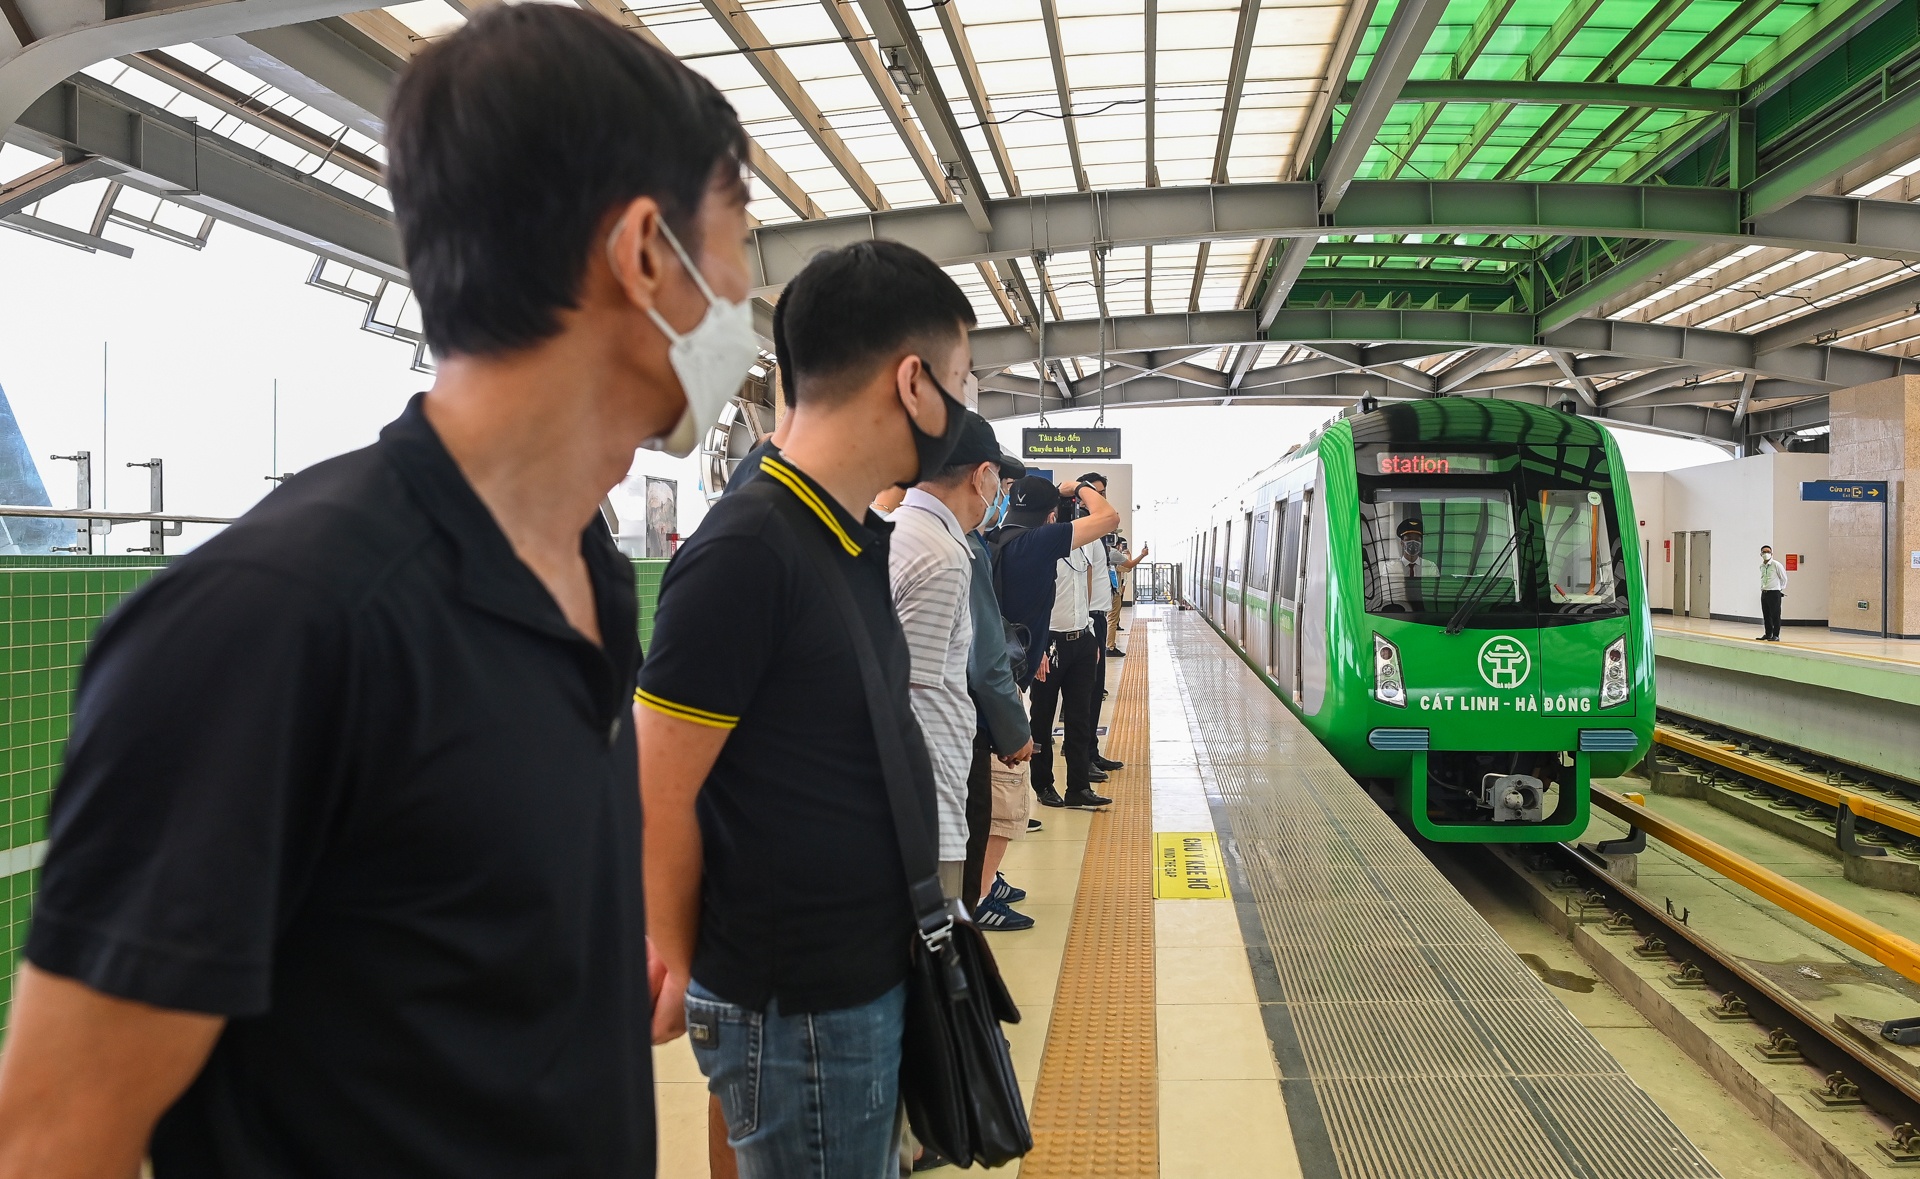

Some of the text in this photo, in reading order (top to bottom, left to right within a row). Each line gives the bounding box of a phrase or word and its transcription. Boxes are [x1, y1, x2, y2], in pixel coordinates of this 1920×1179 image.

[1054, 432, 1066, 442] sắp
[1067, 432, 1080, 442] đến
[1381, 455, 1449, 473] station
[1420, 692, 1454, 711] CÁT
[1460, 696, 1499, 711] LINH
[1515, 694, 1537, 712] HÀ
[1544, 694, 1591, 712] ĐÔNG
[1182, 838, 1207, 852] CHÚ
[1164, 859, 1177, 867] THE
[1185, 860, 1207, 875] KHE
[1164, 868, 1177, 878] GAP
[1187, 878, 1219, 890] HỞ
